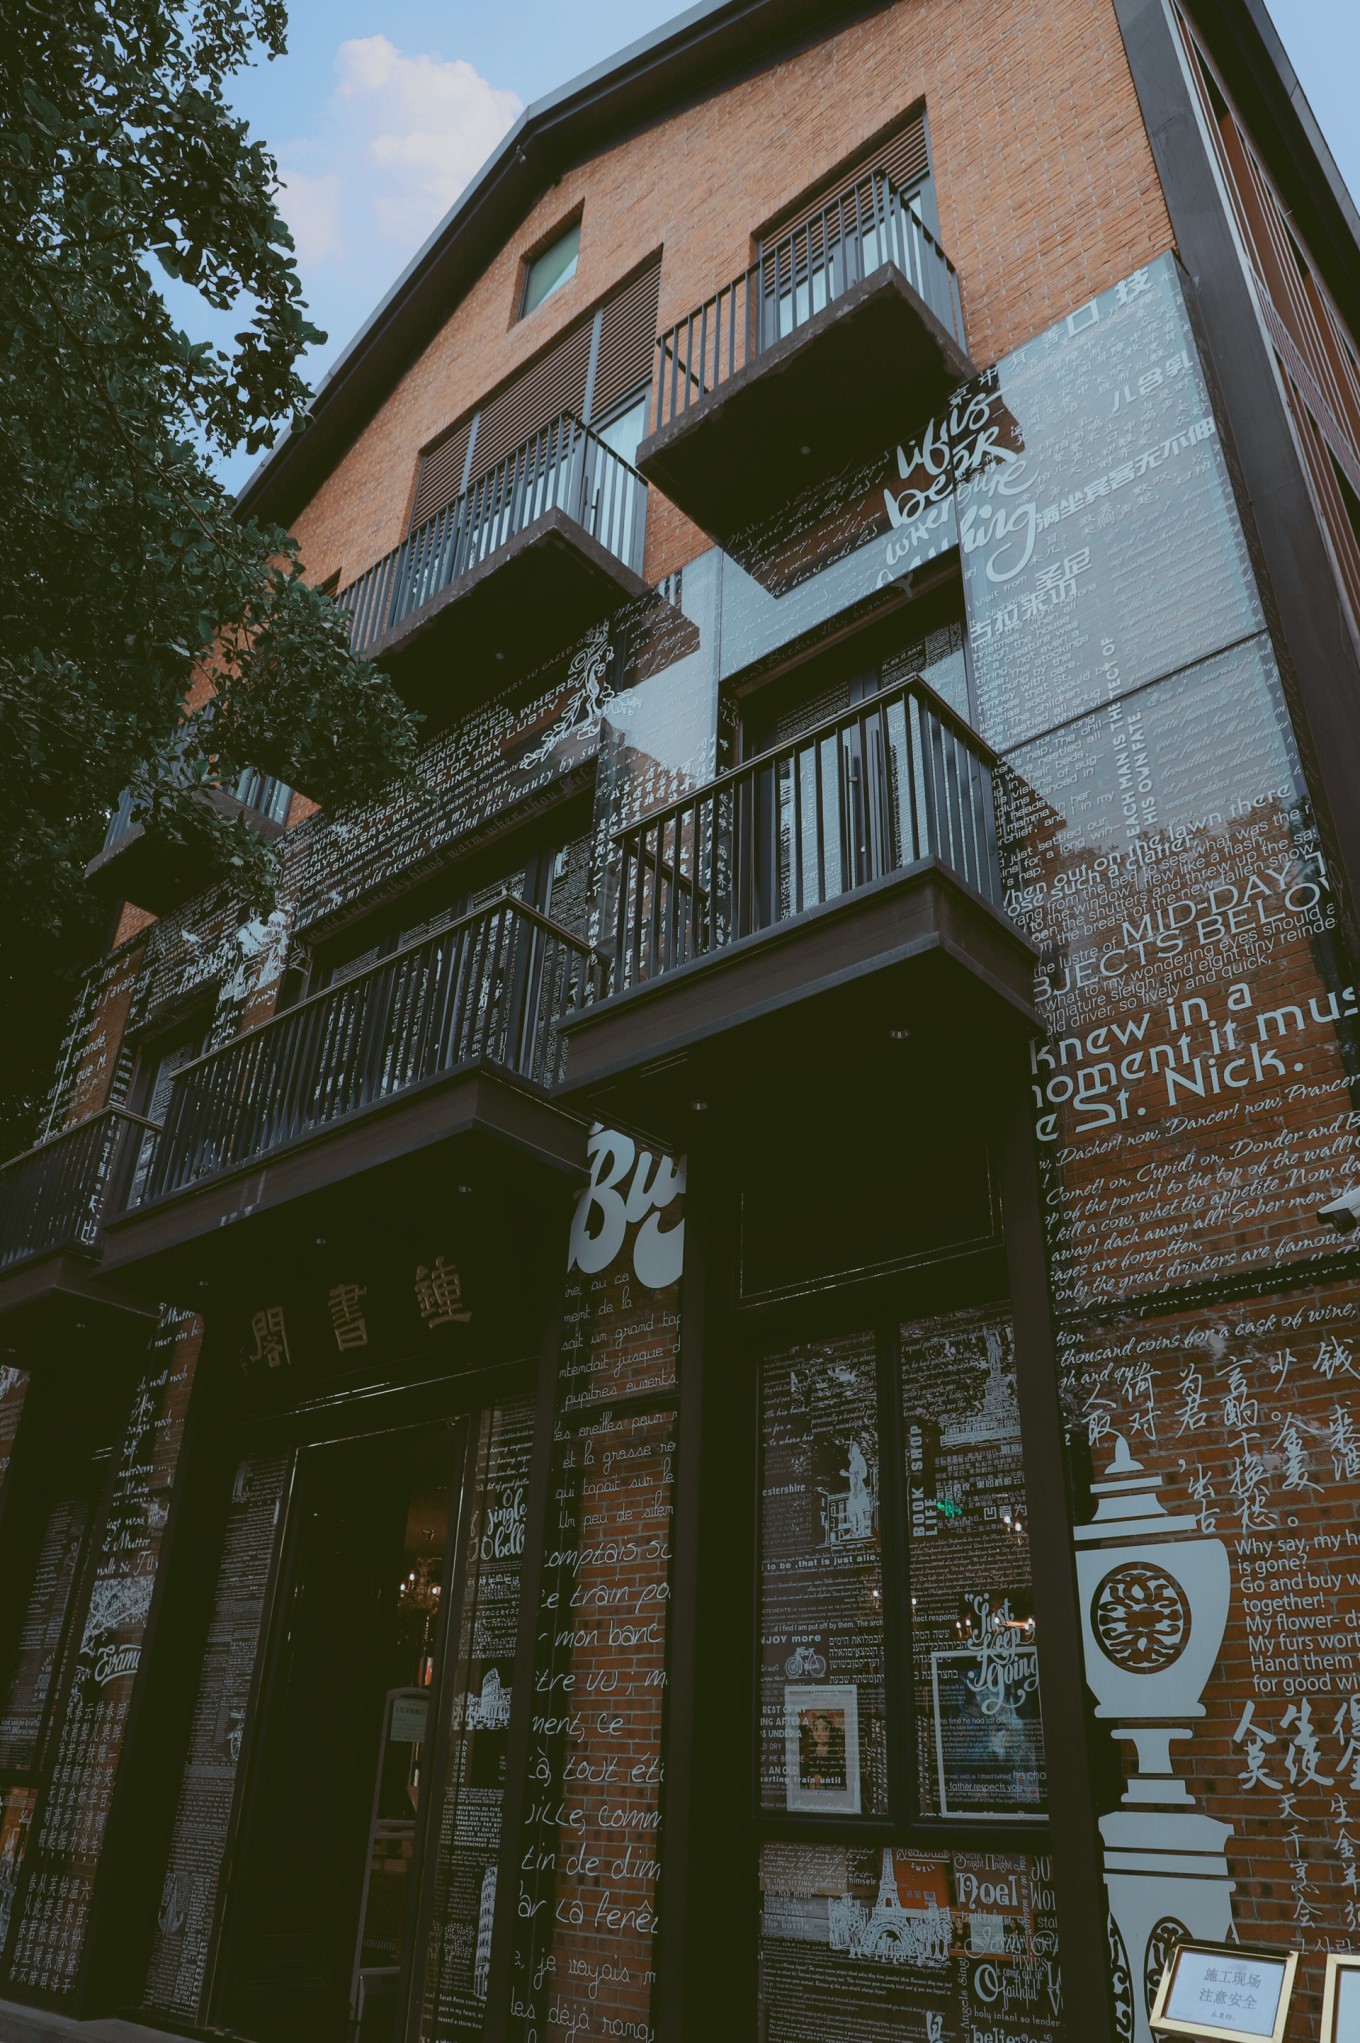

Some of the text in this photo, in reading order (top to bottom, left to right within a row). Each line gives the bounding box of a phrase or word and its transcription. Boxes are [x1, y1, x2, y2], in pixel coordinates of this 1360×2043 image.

[1066, 265, 1153, 339] 口技
[1112, 349, 1194, 413] 儿含乳
[1034, 415, 1218, 534] 满坐宾客无不伸
[1108, 702, 1124, 732] THE
[411, 704, 504, 766] WEED OF SMALL
[450, 699, 559, 776] OF THY LUSTY
[1113, 733, 1127, 751] IS
[415, 743, 455, 776] BEING
[435, 748, 502, 797] THINE OWN
[1115, 753, 1134, 790] MAN
[1127, 708, 1158, 826] HIS OWN FATE.
[484, 756, 575, 818] his beauty by
[1035, 774, 1078, 798] danced
[1070, 790, 1091, 805] her
[1094, 852, 1121, 871] on
[1128, 834, 1161, 858] the
[1167, 811, 1222, 842] lawn
[1229, 783, 1291, 817] there
[1121, 792, 1141, 838] EACH
[331, 839, 377, 872] SUNKEN
[1110, 808, 1300, 888] bed see what was the
[1051, 870, 1101, 901] such
[1084, 842, 1314, 935] breast new-fallen snow
[1089, 838, 1288, 921] shutters threw up the
[1074, 885, 1130, 915] window
[1121, 861, 1293, 947] MID-DAY
[1130, 904, 1320, 981] wondering eyes should
[1029, 983, 1253, 1075] knew in a
[1209, 1022, 1237, 1057] it
[1074, 1088, 1147, 1134] St.
[1164, 1042, 1304, 1107] Nick.
[1056, 1103, 1239, 1167] Dasher! Dancer!
[1046, 1115, 1344, 1205] Comet! Donder and
[1109, 1151, 1299, 1215] porch! the
[1139, 1176, 1279, 1222] whet appetite
[1103, 1222, 1189, 1250] dash away
[1118, 1232, 1343, 1293] great drinkers are famous
[615, 1313, 655, 1349] grand
[614, 1347, 663, 1378] jusque
[1060, 1338, 1137, 1367] thousand
[631, 1413, 664, 1436] pour
[602, 1445, 652, 1475] grosse
[910, 1425, 925, 1537] BOOK SHOP
[616, 1501, 633, 1522] de
[924, 1498, 938, 1536] LIFE
[780, 1561, 792, 1569] be
[821, 1555, 830, 1566] is
[833, 1554, 853, 1567] just
[1234, 1534, 1341, 1557] Why my
[1255, 1553, 1307, 1577] gone?
[569, 1577, 629, 1608] train
[1240, 1572, 1342, 1593] Go and buy
[1243, 1591, 1325, 1616] together!
[555, 1619, 664, 1648] mon banc
[792, 1635, 821, 1643] more
[857, 1620, 868, 1628] The
[1246, 1615, 1272, 1636] My
[1248, 1633, 1313, 1655] My furs
[1250, 1653, 1352, 1672] Hand them
[1253, 1672, 1331, 1696] for good
[562, 1755, 619, 1782] tout
[566, 1841, 600, 1876] de
[910, 1862, 936, 1873] SWELL
[533, 1947, 631, 2000] je voyais
[1203, 1967, 1262, 1989] 施工现场
[1200, 1988, 1258, 2010] 注意安全
